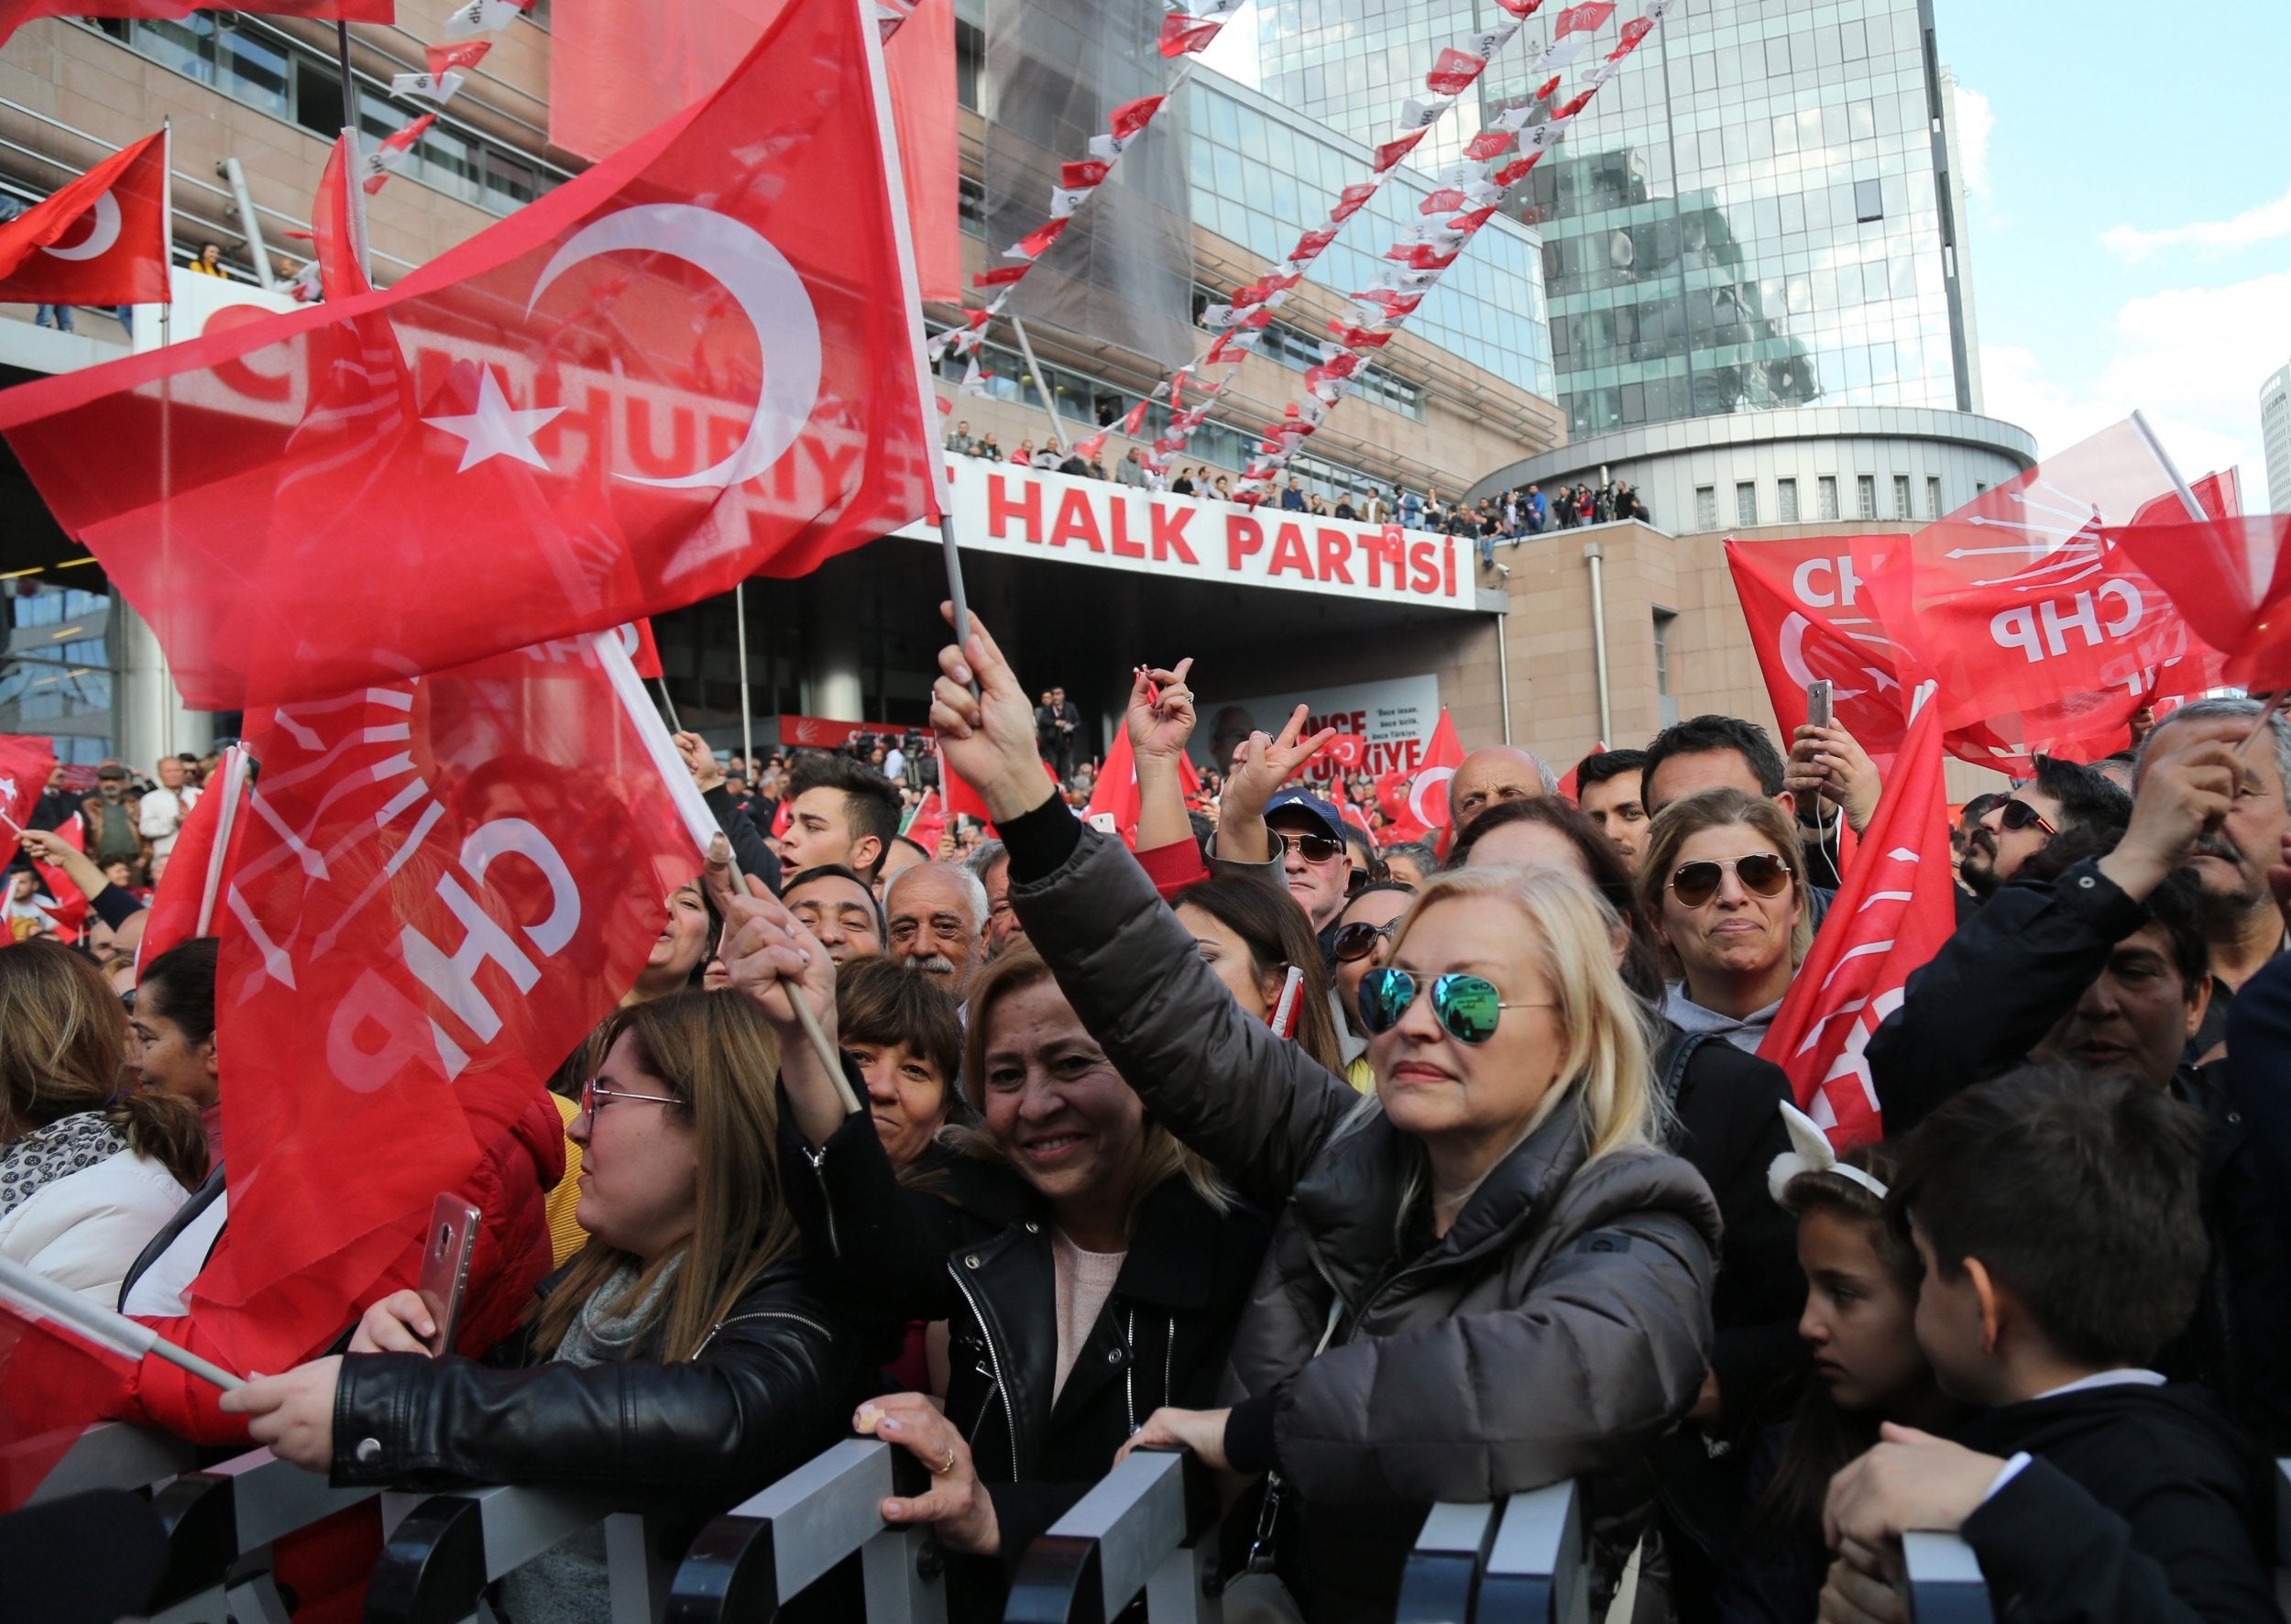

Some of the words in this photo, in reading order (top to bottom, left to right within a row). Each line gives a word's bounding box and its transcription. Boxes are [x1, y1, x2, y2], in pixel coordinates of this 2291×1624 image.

[468, 0, 483, 24] HP
[203, 303, 955, 527] CMHURYET
[988, 474, 1200, 565] HALK
[1289, 710, 1367, 746] NCE
